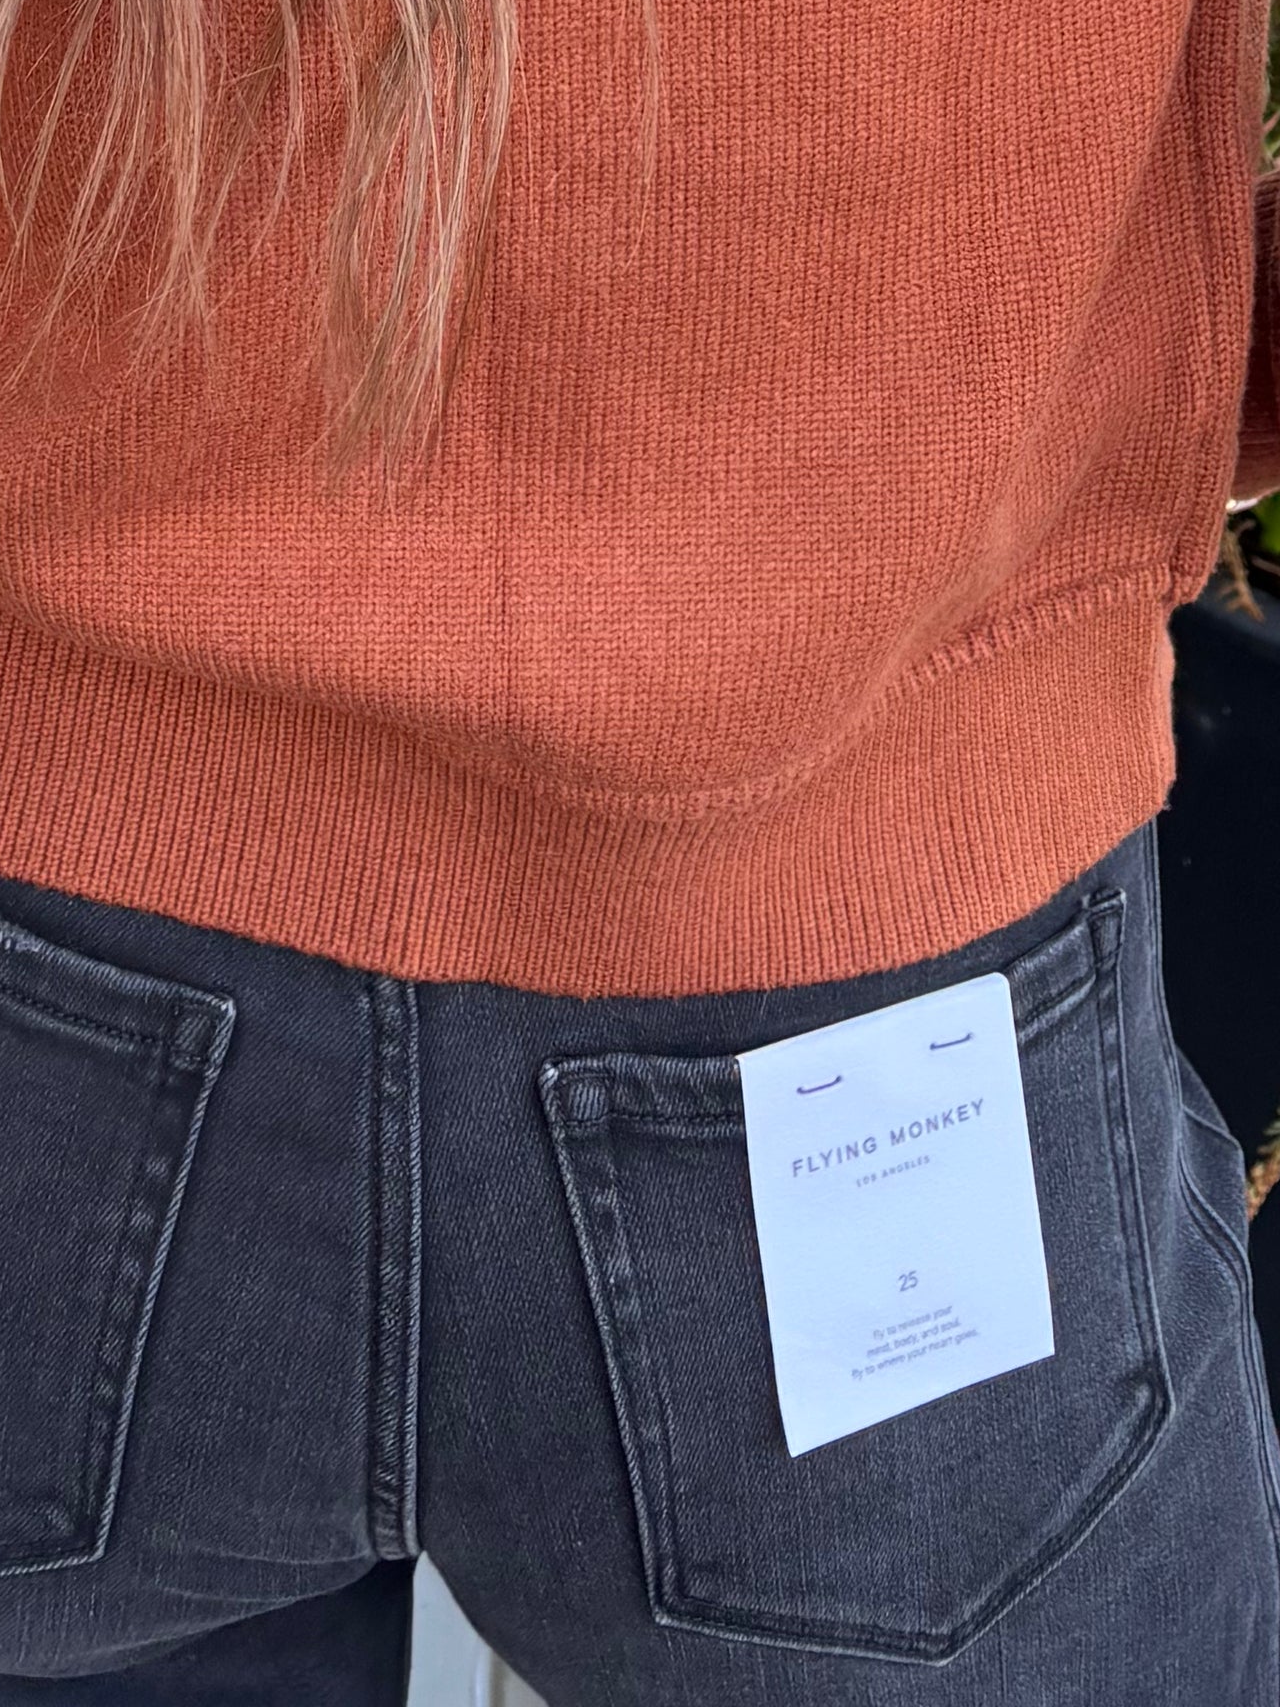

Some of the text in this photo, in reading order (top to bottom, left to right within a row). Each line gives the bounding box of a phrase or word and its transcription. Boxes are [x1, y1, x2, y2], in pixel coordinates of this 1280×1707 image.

[791, 1097, 985, 1178] FLYING MONKEY
[898, 1269, 919, 1292] 25
